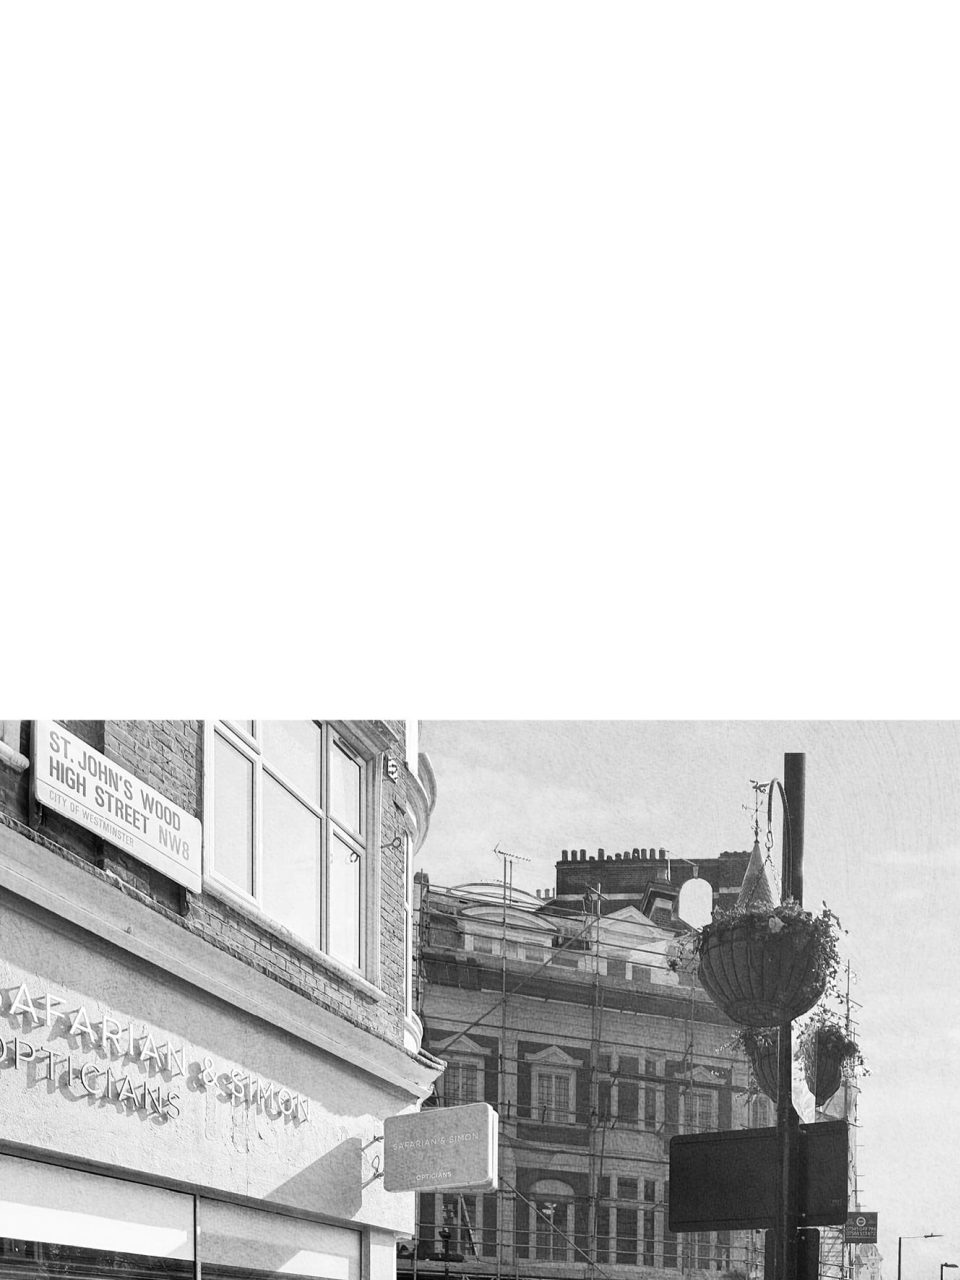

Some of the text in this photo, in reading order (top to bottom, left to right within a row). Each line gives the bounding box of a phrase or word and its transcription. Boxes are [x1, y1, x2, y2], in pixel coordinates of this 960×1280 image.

[49, 730, 181, 832] ST. JOHN'S WOOD
[49, 756, 190, 861] HIGH STREET NW8
[49, 790, 134, 848] CITY OF WESTMINSTER
[0, 983, 309, 1123] AFARIAN & SIMON
[392, 1139, 437, 1151] SAFARIAN
[449, 1132, 479, 1144] SIMON
[416, 1171, 452, 1181] OPTICIANS
